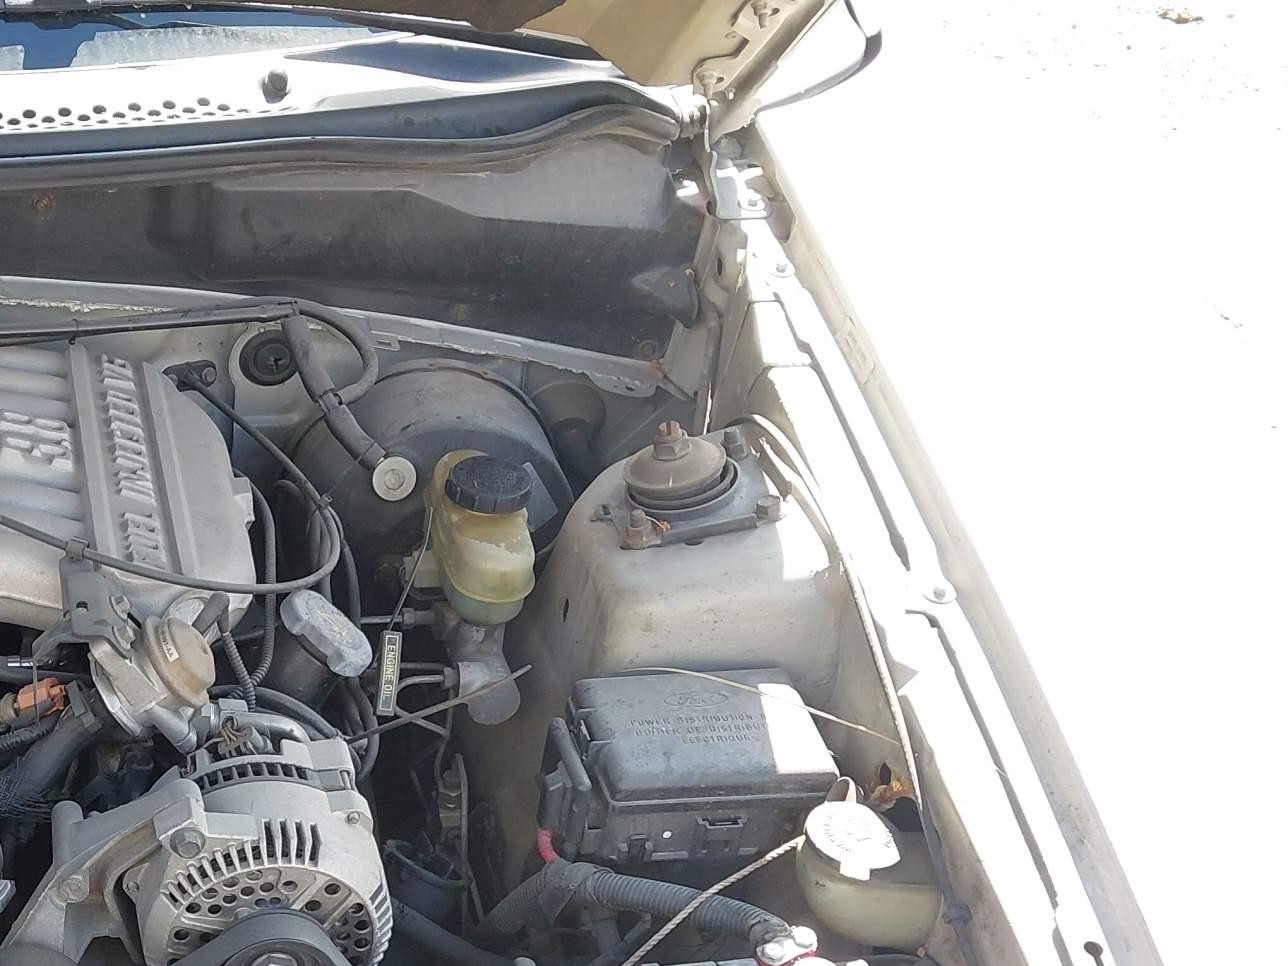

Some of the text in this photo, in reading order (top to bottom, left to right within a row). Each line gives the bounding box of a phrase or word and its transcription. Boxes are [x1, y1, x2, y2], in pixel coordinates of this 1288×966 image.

[383, 644, 396, 700] ENGINE OIL
[628, 716, 671, 728] POWER
